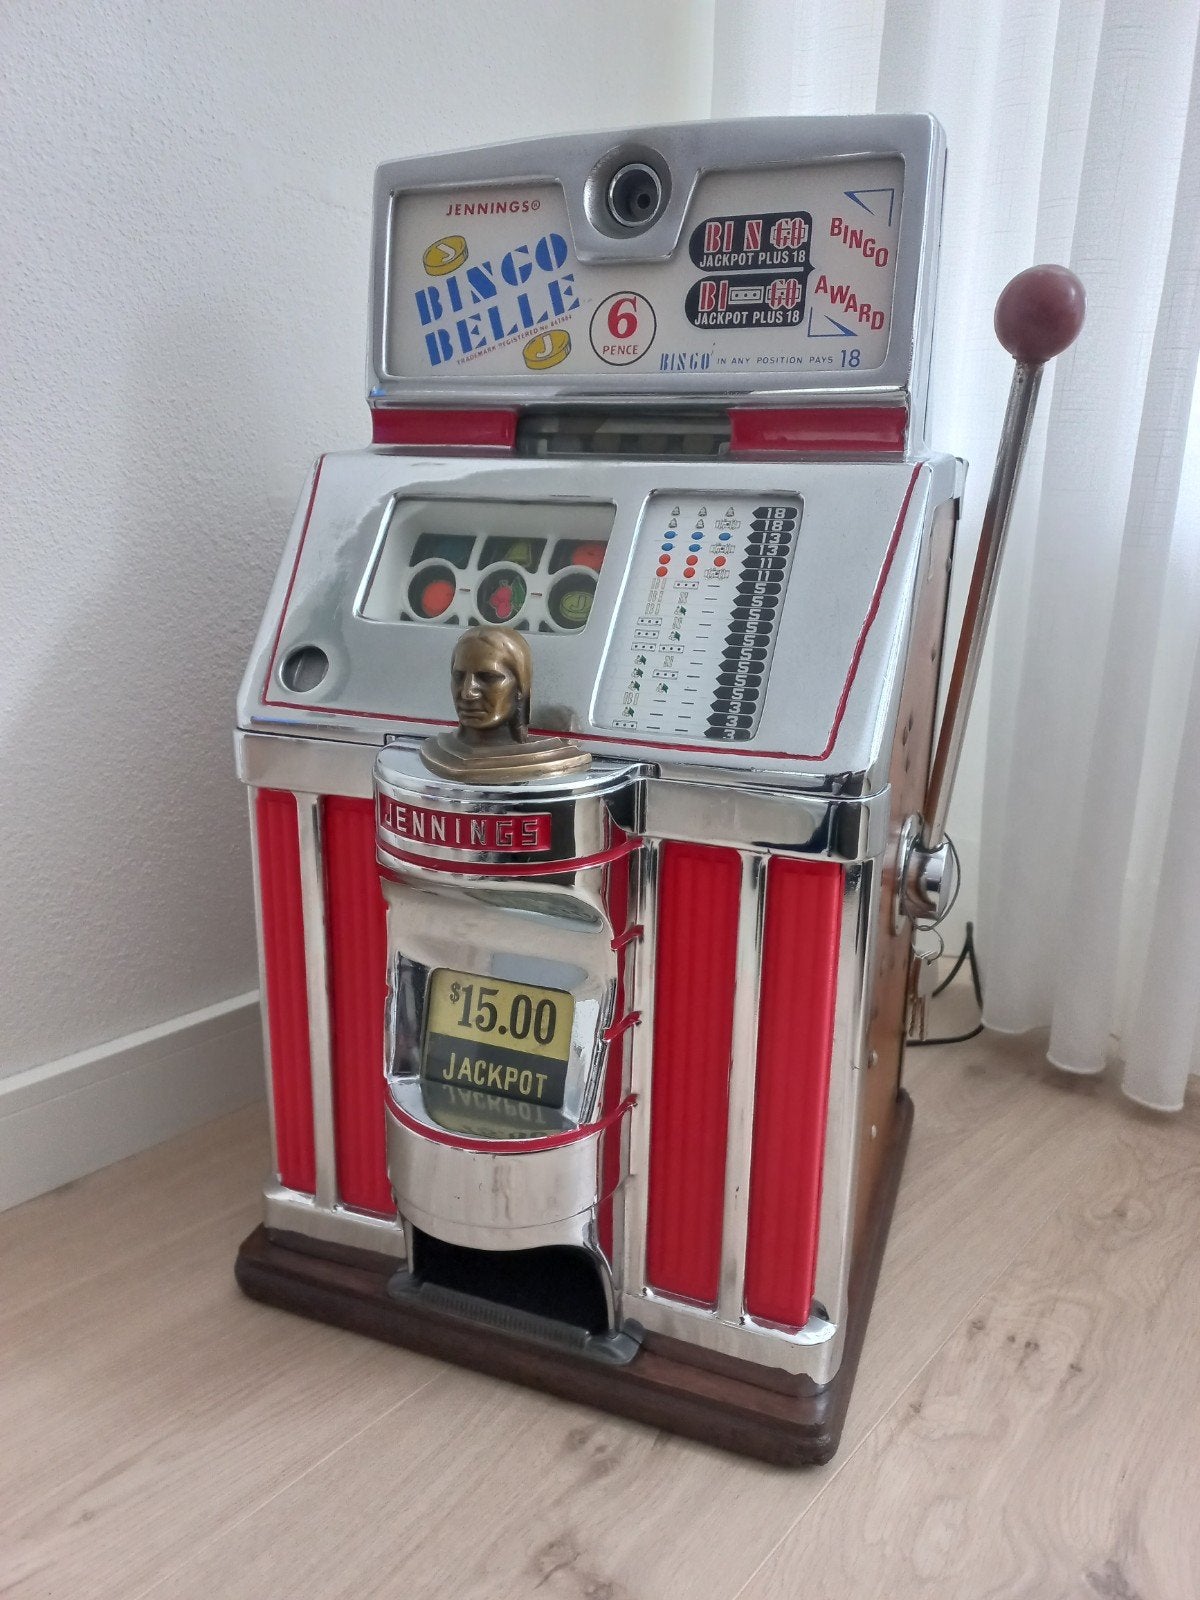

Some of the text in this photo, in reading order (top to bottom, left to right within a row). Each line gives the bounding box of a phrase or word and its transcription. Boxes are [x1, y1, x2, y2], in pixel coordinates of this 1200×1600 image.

[830, 217, 889, 268] BINGO
[699, 250, 806, 267] JACKPOT PLUS 18
[414, 233, 568, 326] BINGO
[814, 274, 885, 330] AWARD
[425, 273, 580, 367] BELLE
[607, 296, 638, 339] 6
[694, 310, 800, 325] JACKPOT PLUS 18
[457, 345, 497, 365] TRADEMARK
[602, 345, 638, 355] PENCE
[659, 348, 861, 371] BINGO IN ANY POSITION PAYS 18
[767, 508, 786, 519] 18
[764, 520, 784, 531] 18
[761, 532, 781, 544] 13
[759, 544, 779, 556] 13
[760, 557, 773, 569] 11
[757, 570, 770, 582] 11
[754, 582, 767, 594] 5
[751, 595, 764, 607] 5
[748, 608, 762, 620] 5
[745, 621, 759, 633] 5
[742, 634, 756, 647] 5
[740, 648, 753, 661] 5
[737, 661, 750, 674] 5
[734, 674, 748, 687] 5
[731, 687, 745, 700] 5
[728, 701, 741, 714] 3
[725, 715, 739, 727] 3
[722, 729, 736, 739] 3
[384, 803, 539, 847] JENNINGS
[449, 979, 557, 1045] $15.00
[442, 1052, 548, 1099] JACKPOT
